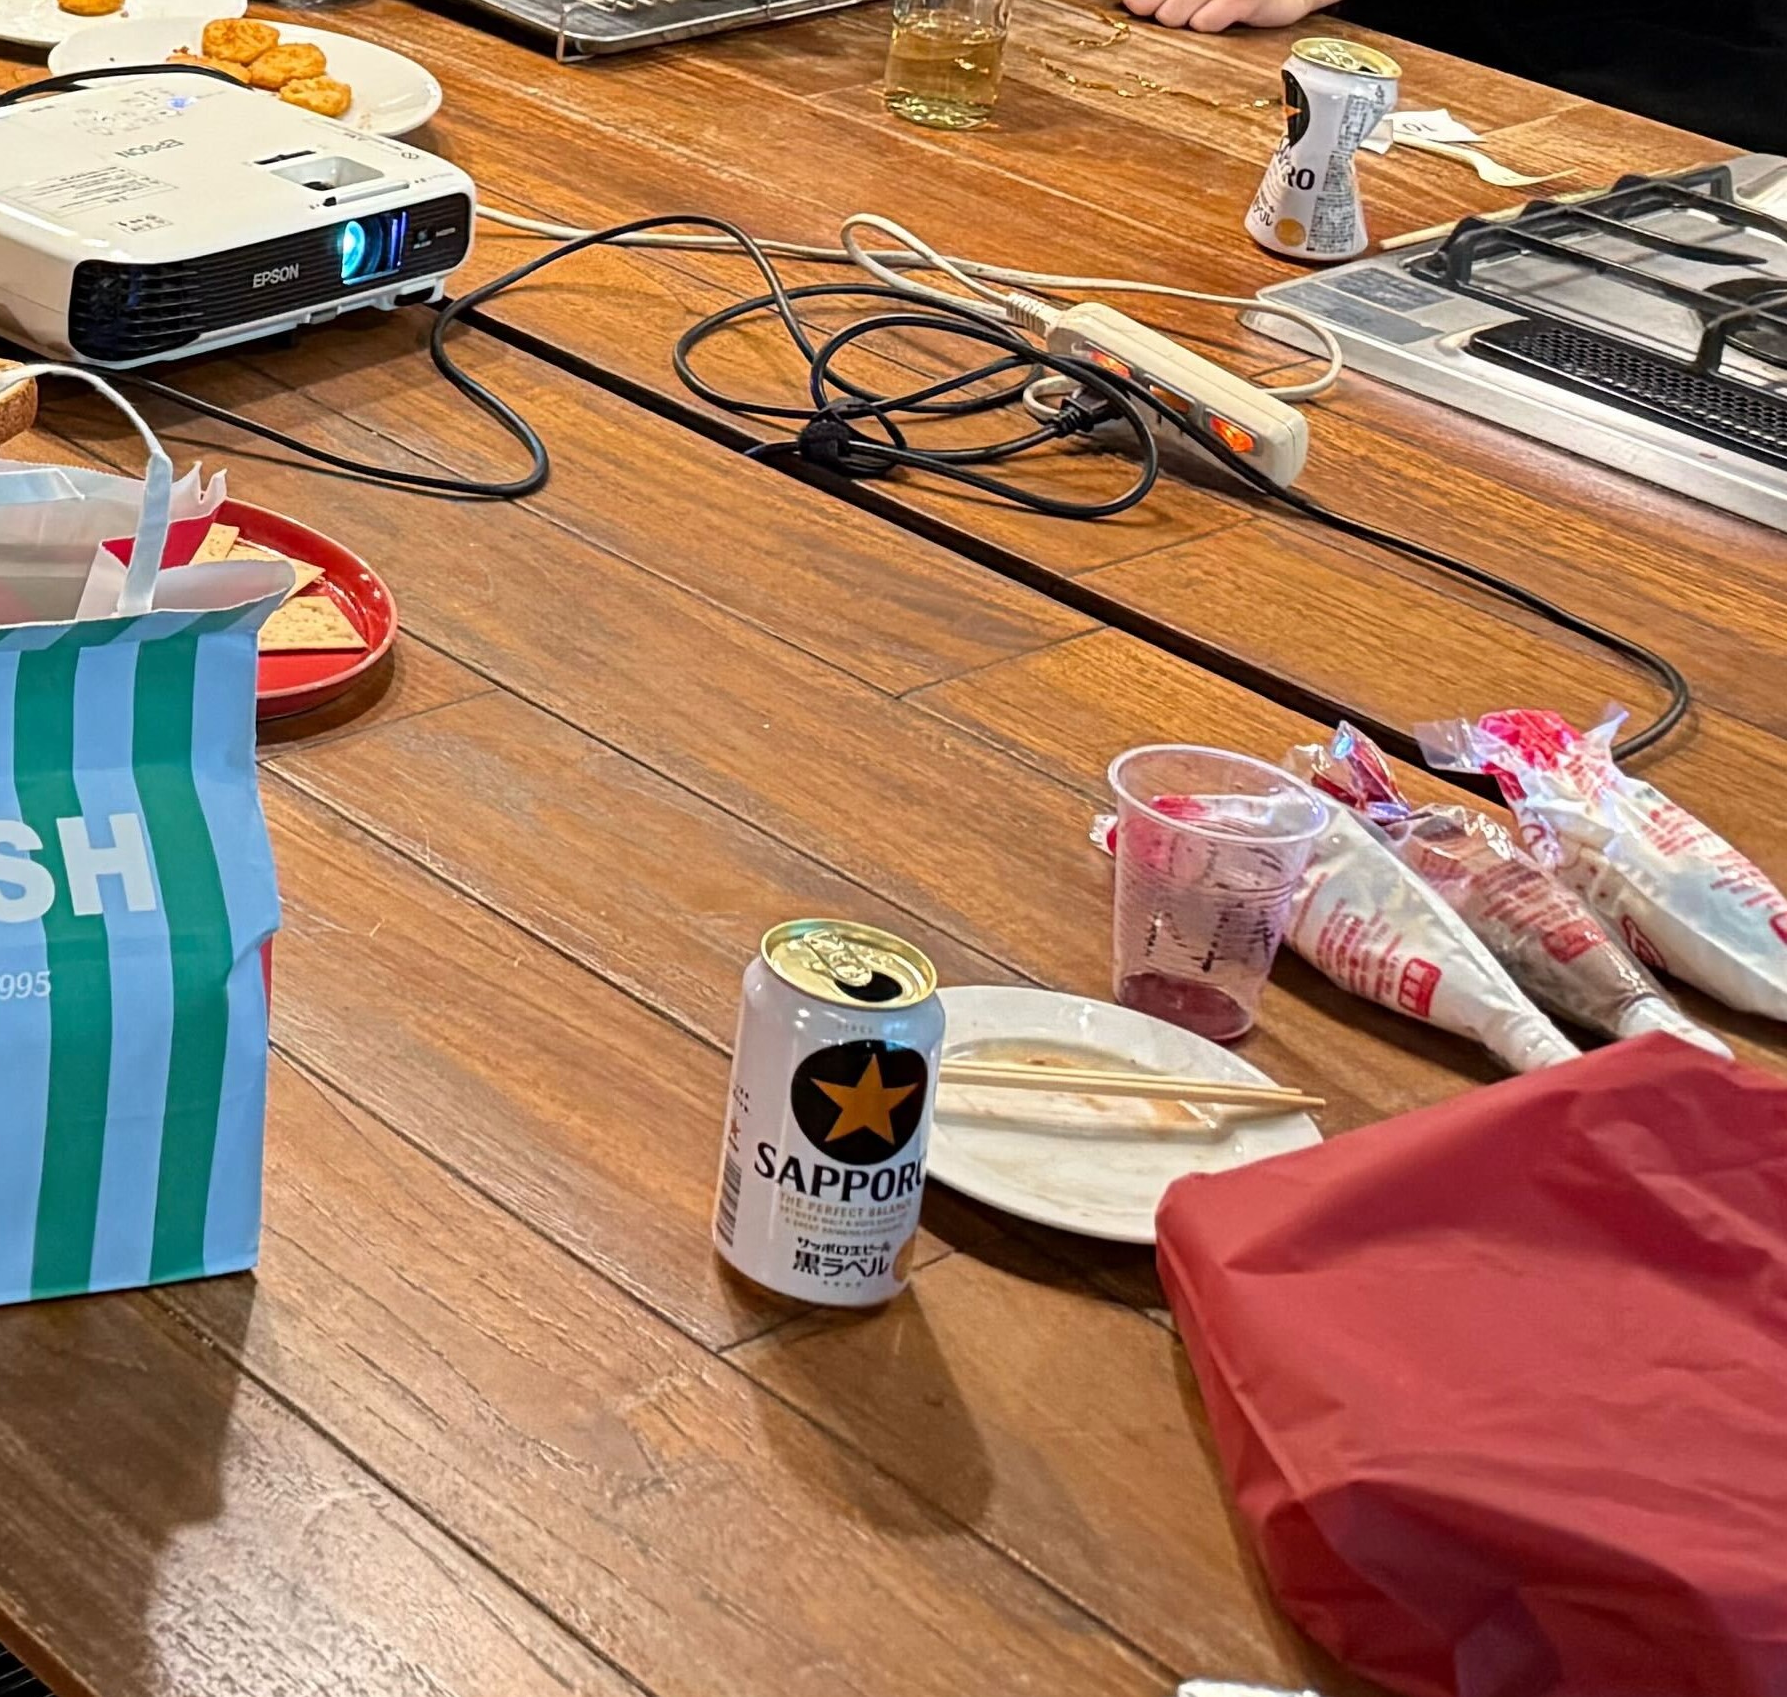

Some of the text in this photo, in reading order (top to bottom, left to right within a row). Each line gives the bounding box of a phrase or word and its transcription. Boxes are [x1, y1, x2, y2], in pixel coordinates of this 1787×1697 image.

[114, 139, 185, 159] EPSON
[253, 263, 300, 289] EPSON
[793, 1250, 890, 1278] 黒ラベル
